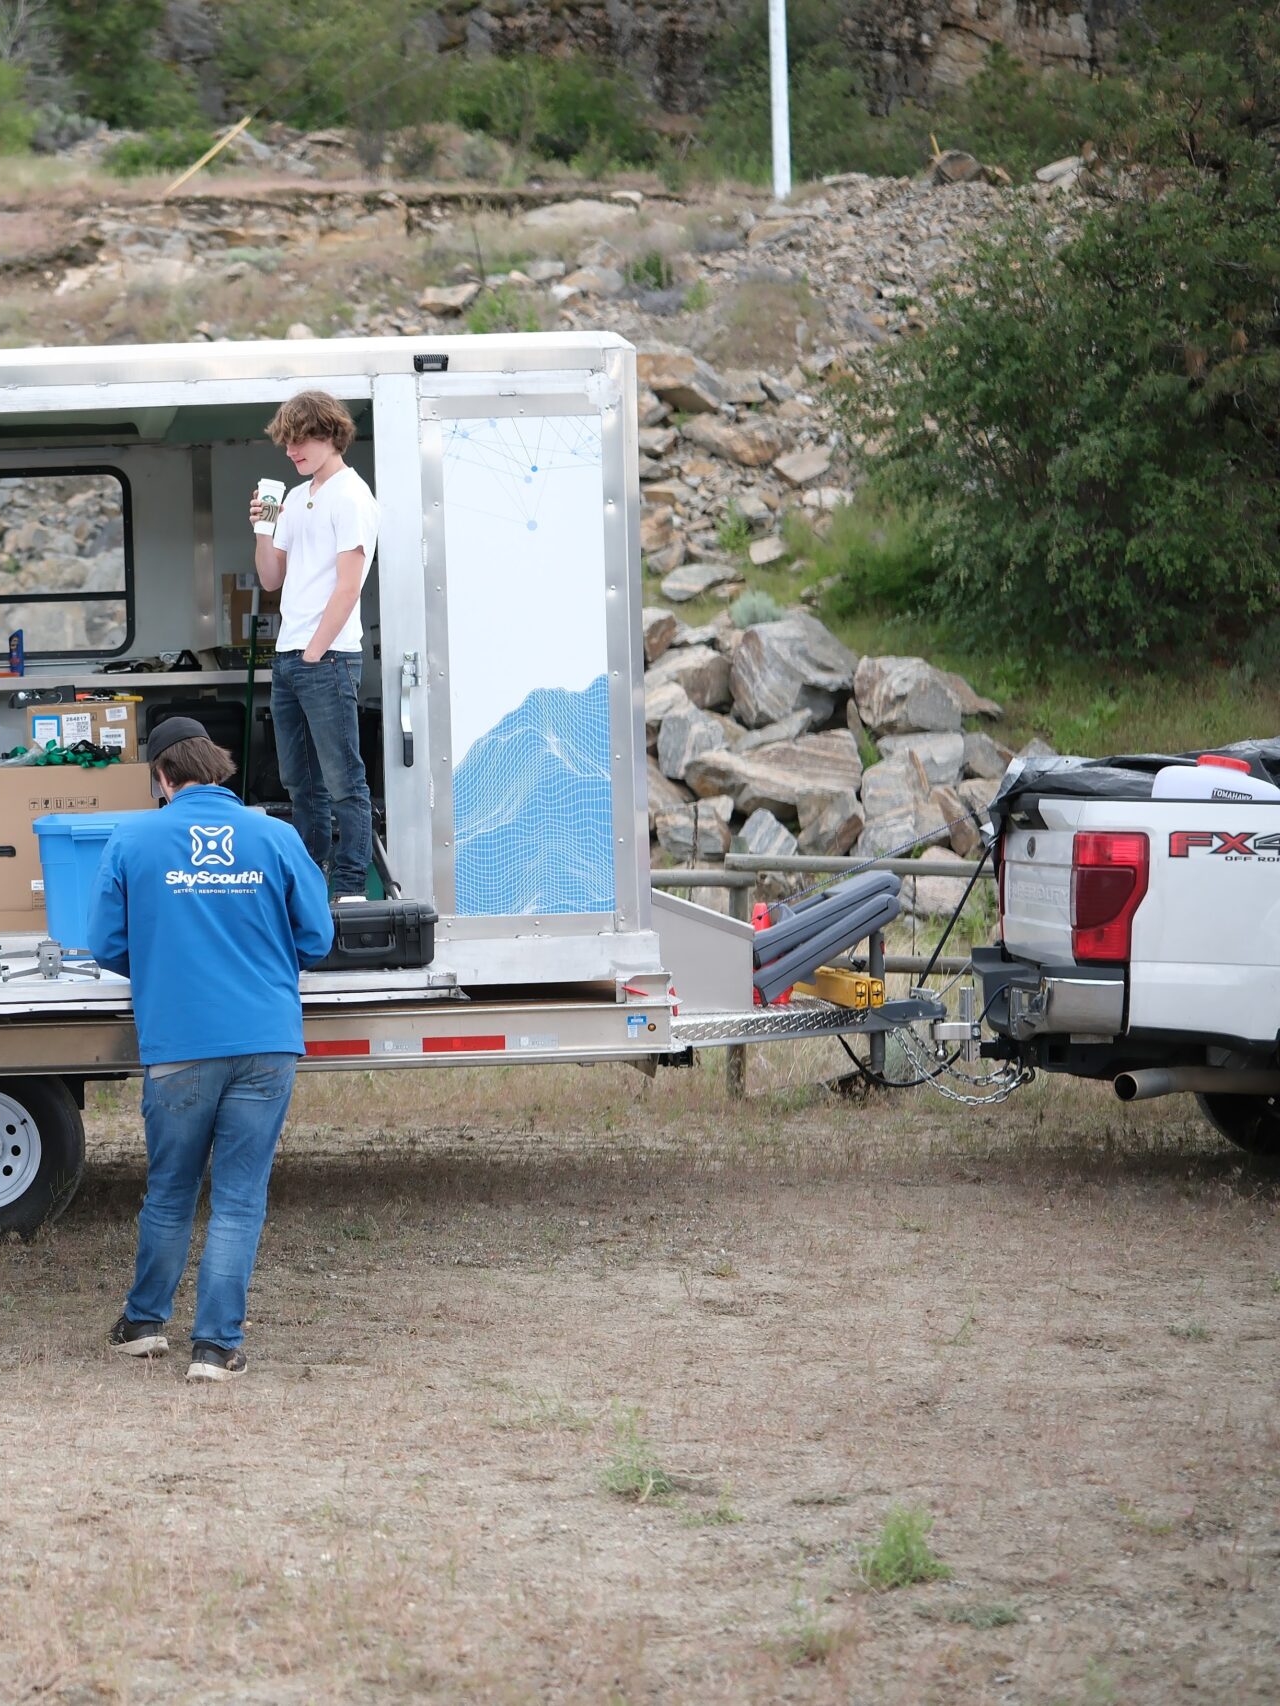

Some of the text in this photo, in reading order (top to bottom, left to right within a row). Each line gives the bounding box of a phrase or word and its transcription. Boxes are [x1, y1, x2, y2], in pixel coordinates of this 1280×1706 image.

[1213, 789, 1252, 800] TOMAHAWK
[1168, 831, 1280, 858] FX4
[165, 870, 264, 887] SkyScoutAi
